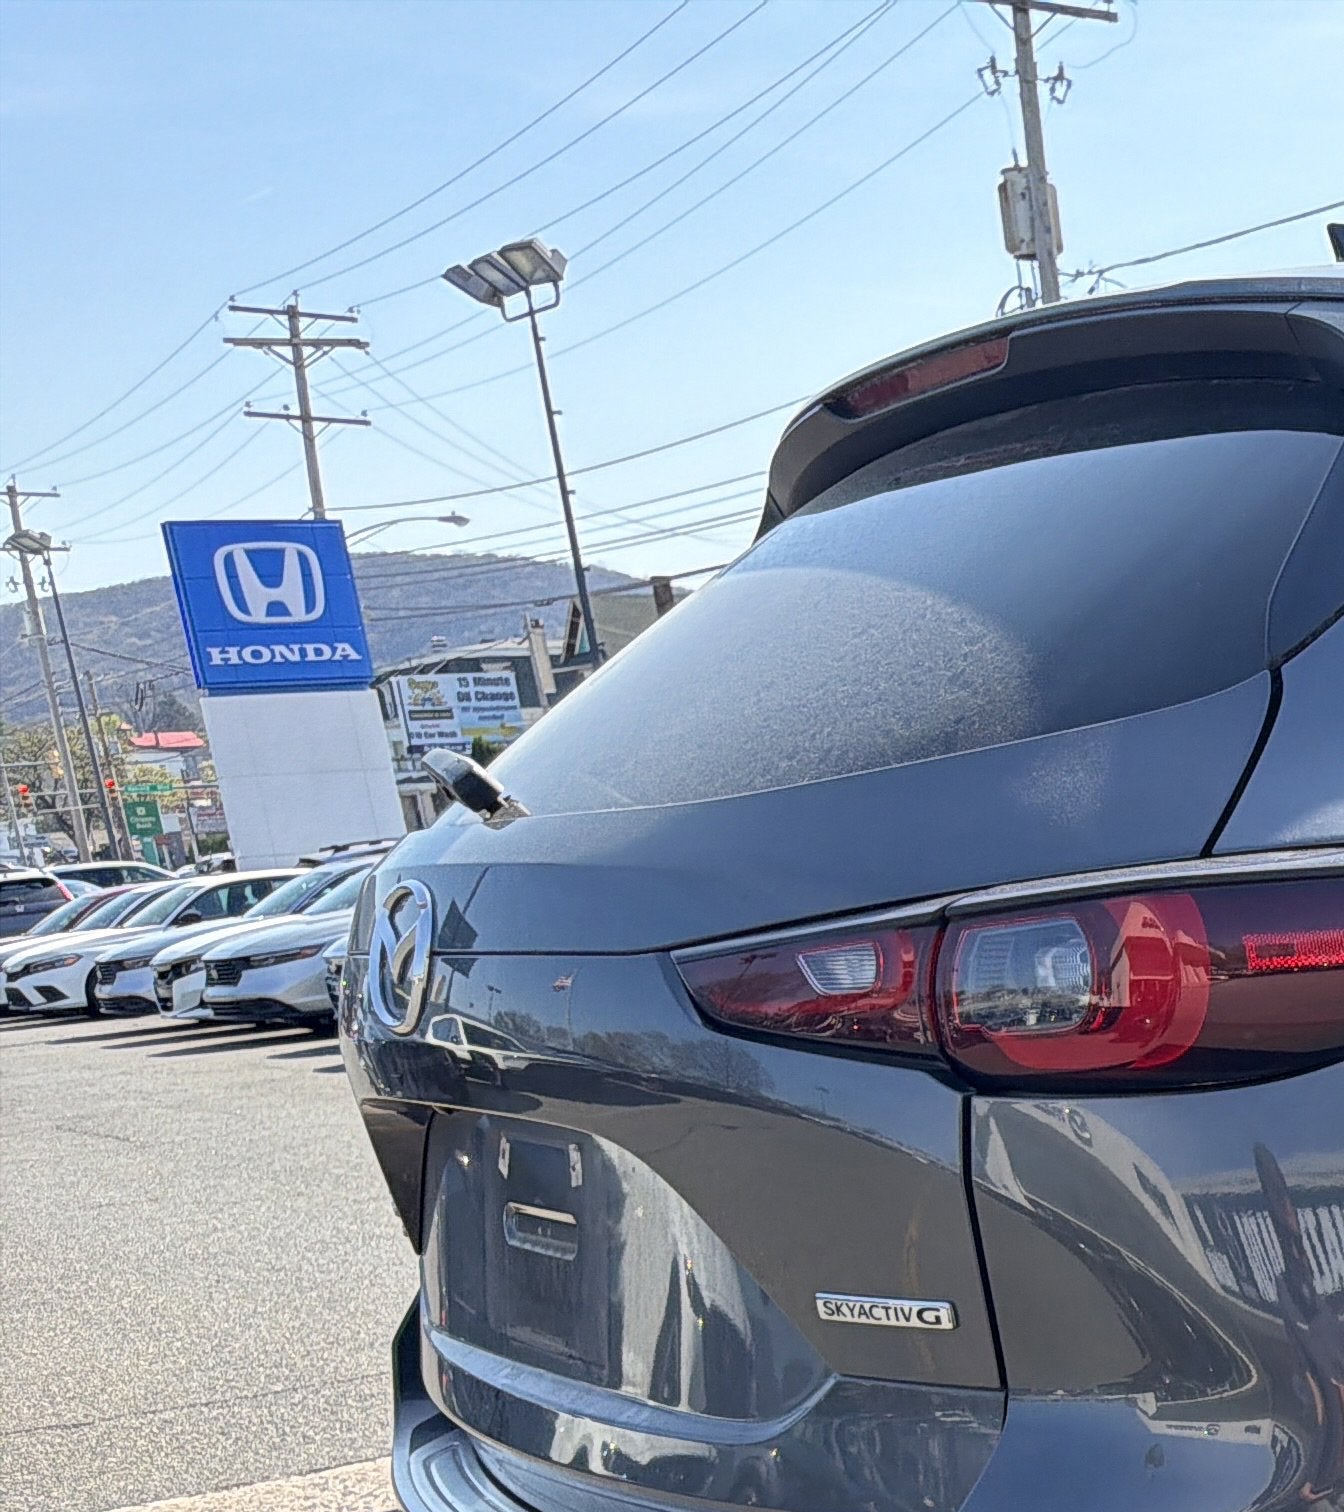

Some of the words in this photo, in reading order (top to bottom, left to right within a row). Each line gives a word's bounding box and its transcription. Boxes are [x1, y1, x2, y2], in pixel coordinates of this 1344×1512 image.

[206, 642, 363, 666] HONDA
[456, 676, 470, 689] 15
[472, 675, 512, 688] Minute
[456, 691, 472, 703] Oil
[474, 690, 517, 702] Change
